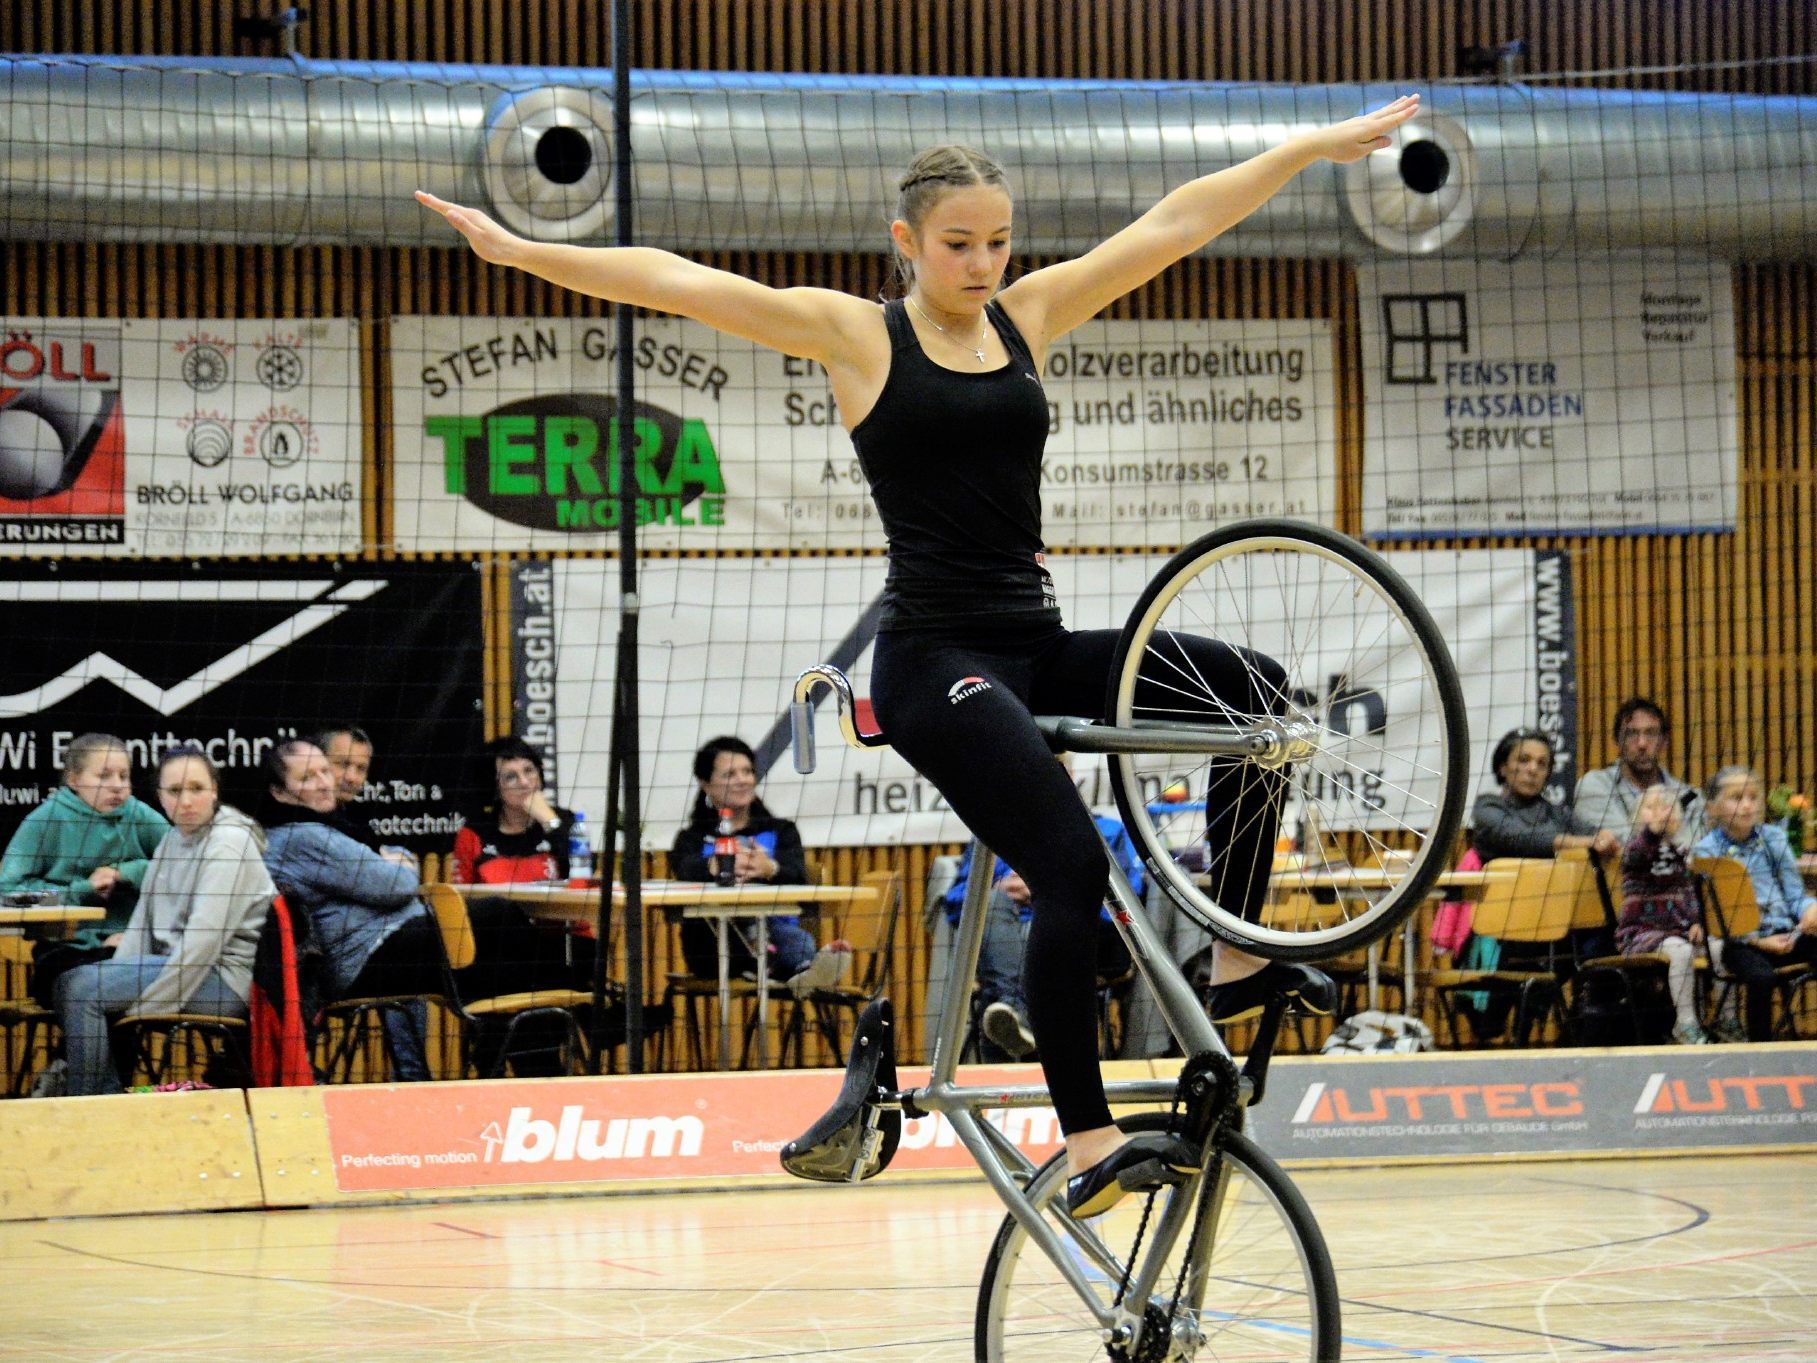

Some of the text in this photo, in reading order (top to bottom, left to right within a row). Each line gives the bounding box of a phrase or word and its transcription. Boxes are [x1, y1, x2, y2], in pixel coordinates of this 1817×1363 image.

[0, 330, 111, 382] ÖLL
[421, 328, 728, 401] STEFAN GSSER
[1043, 343, 1303, 382] olzverarbeitung
[1444, 362, 1557, 386] FENSTER
[1073, 391, 1135, 425] und
[1147, 388, 1302, 424] ähnliches
[1444, 394, 1583, 419] FASSADEN
[1446, 426, 1554, 450] SERVICE
[425, 415, 726, 495] TERRA
[1041, 457, 1230, 484] Konsumstrasse
[1239, 455, 1268, 482] 12
[137, 479, 353, 504] BRÖLL WOLFGANG
[0, 523, 118, 541] RUNGEN
[950, 680, 992, 705] skinfit
[500, 1106, 704, 1163] blum
[341, 1151, 477, 1169] Perfecting motion
